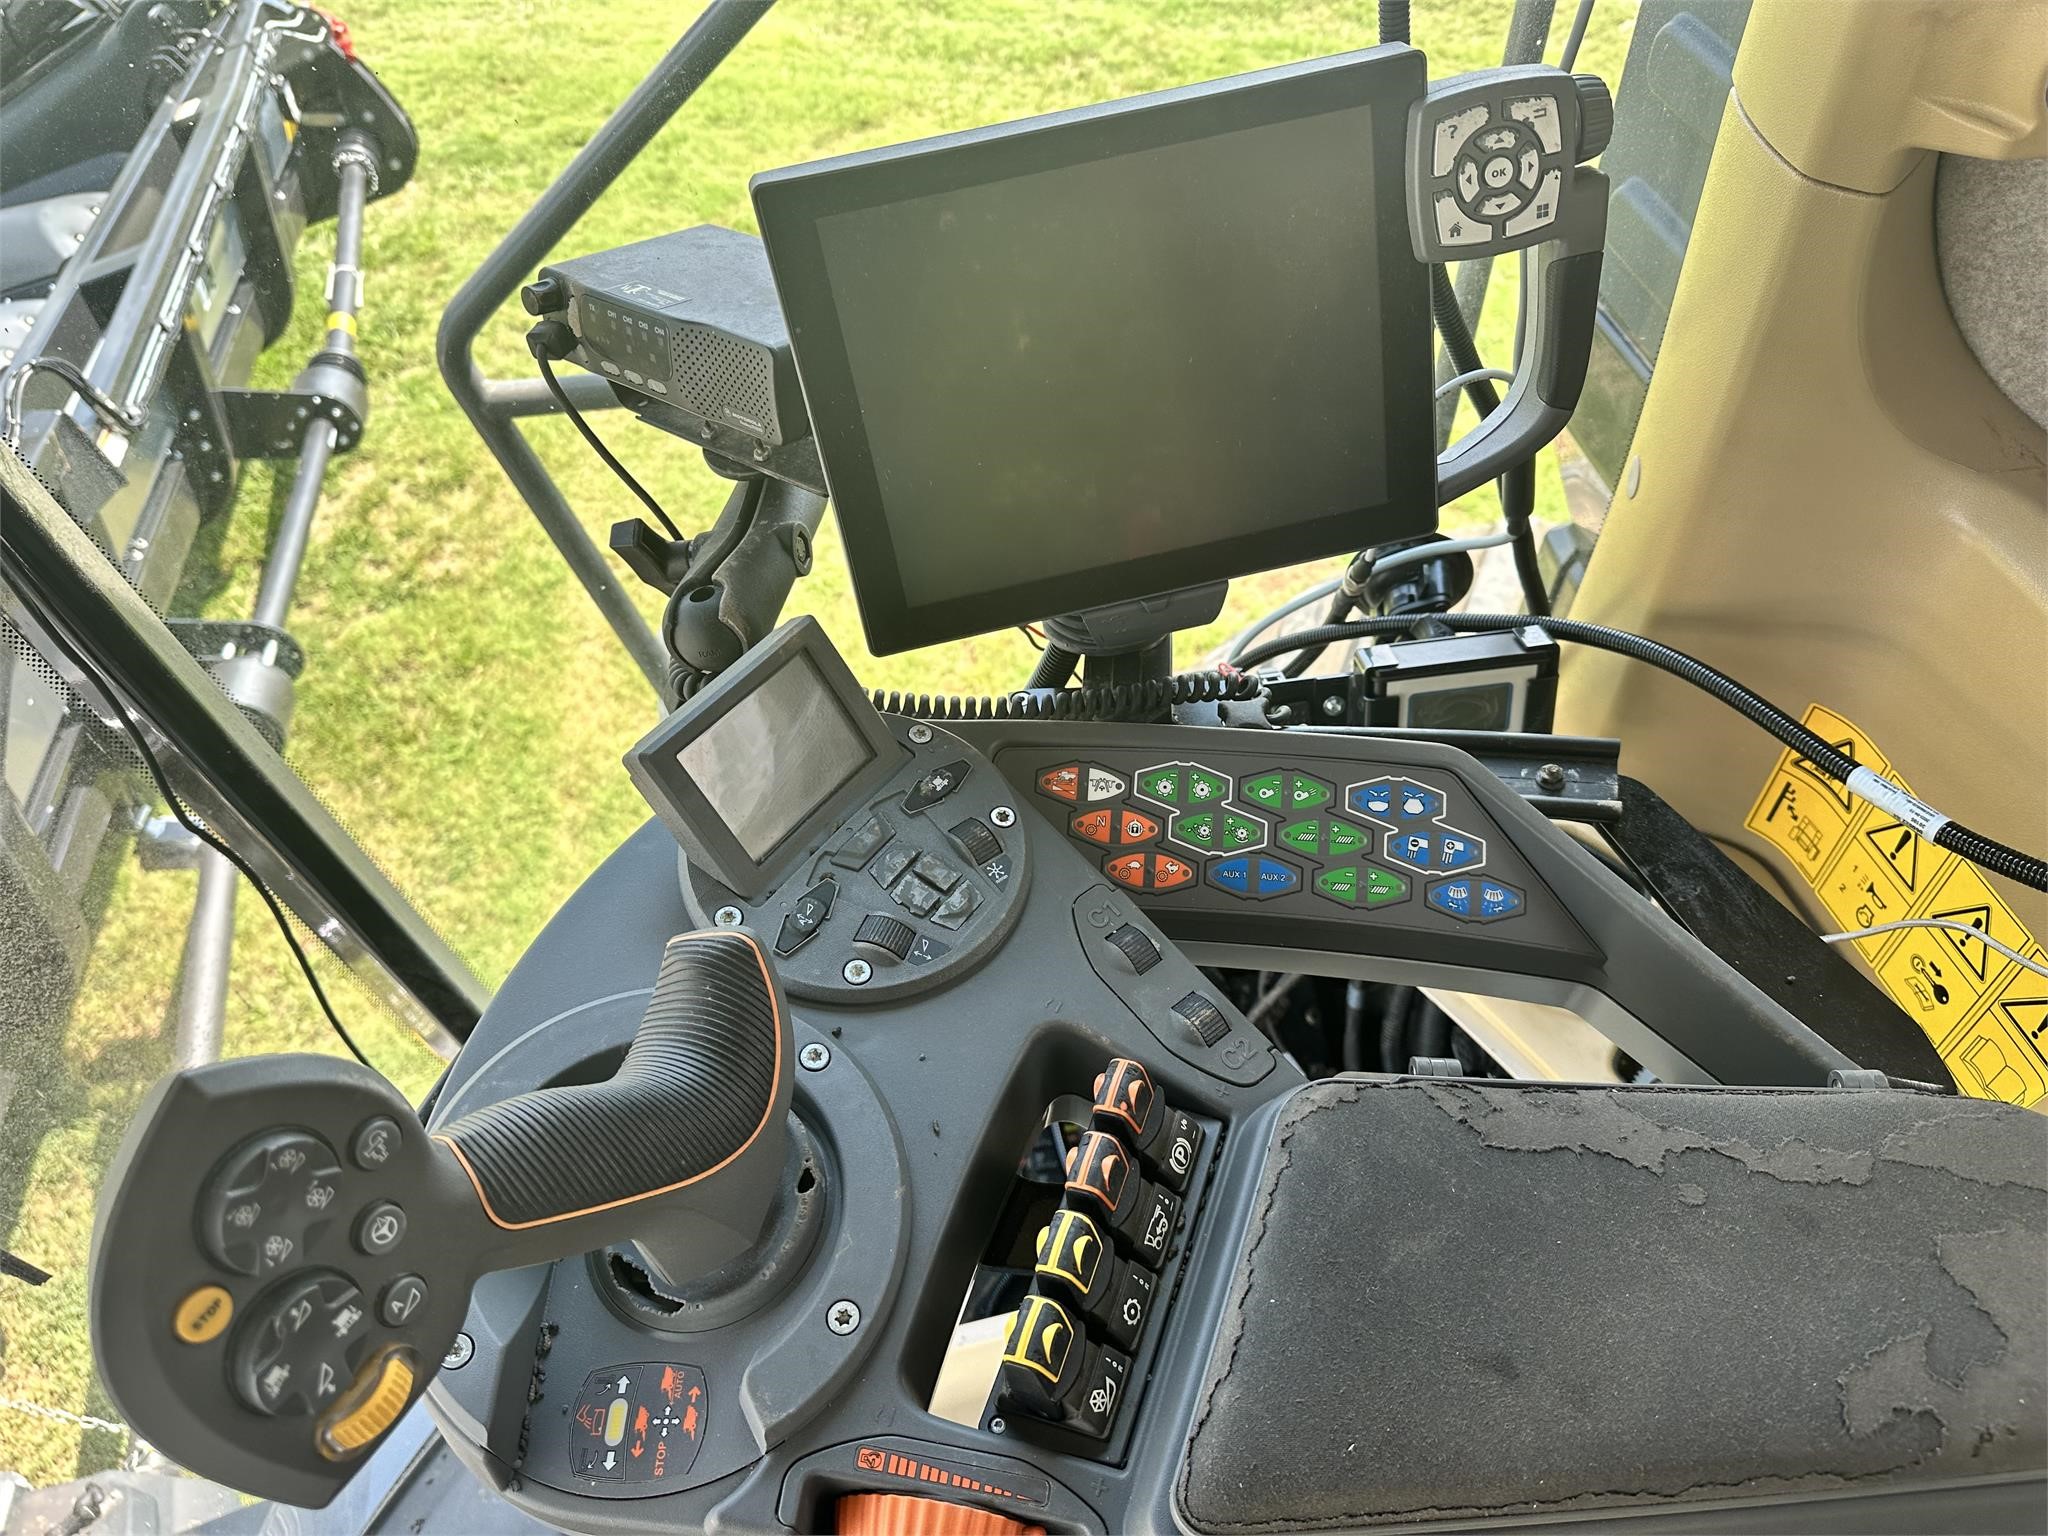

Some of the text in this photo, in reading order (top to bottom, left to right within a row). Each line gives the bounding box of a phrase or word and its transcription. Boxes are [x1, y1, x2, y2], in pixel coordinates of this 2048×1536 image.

[1491, 167, 1506, 178] OK
[622, 315, 633, 325] CH2
[654, 326, 665, 336] CH4
[1096, 816, 1106, 827] N
[1222, 870, 1240, 878] AUX
[1261, 873, 1286, 882] AUX 2
[1087, 900, 1121, 928] C1
[1220, 1038, 1259, 1070] C2
[191, 1297, 222, 1332] STOP
[391, 1301, 404, 1314] A
[674, 1371, 685, 1399] AUTO
[654, 1441, 667, 1476] STOP
